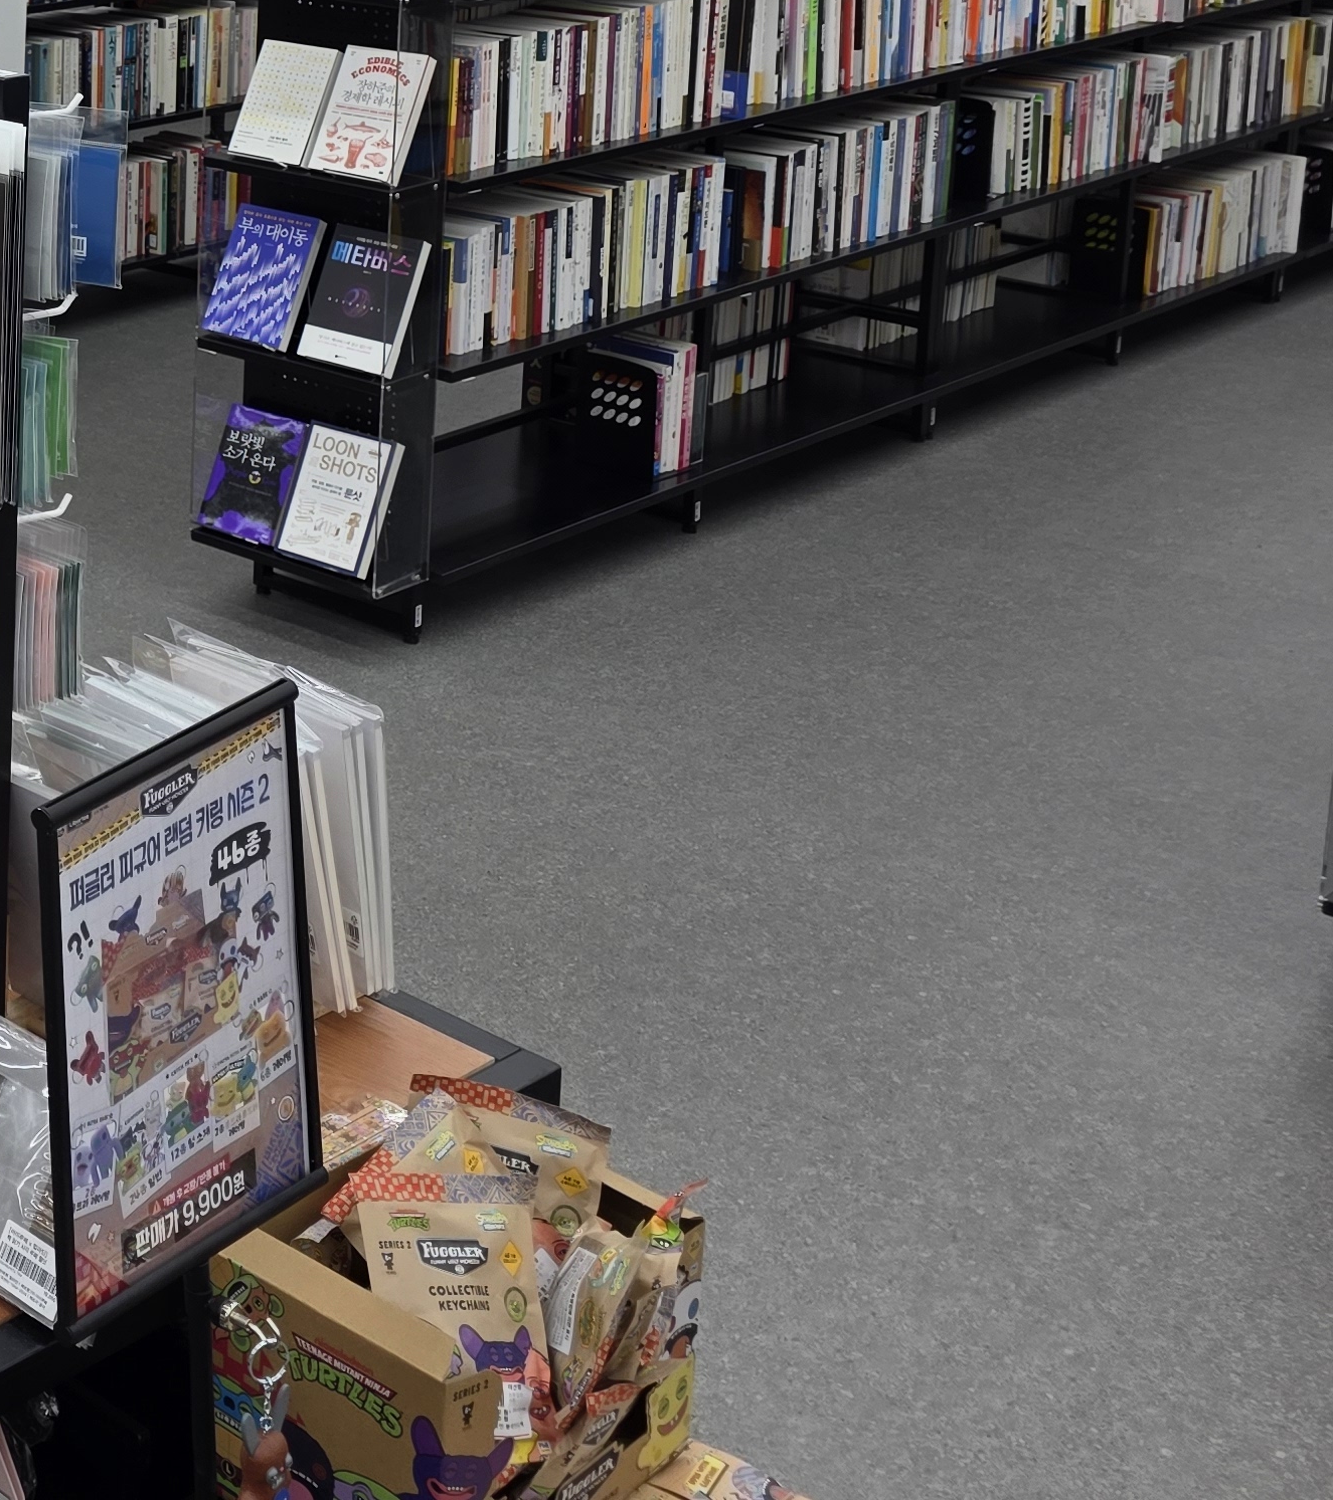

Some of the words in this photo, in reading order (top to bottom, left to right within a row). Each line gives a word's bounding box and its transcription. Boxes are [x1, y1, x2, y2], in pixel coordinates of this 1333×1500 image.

[351, 64, 411, 87] ECONOMICS
[367, 56, 404, 70] EDIBLE
[238, 216, 264, 238] 부의
[266, 223, 309, 248] 대이동
[331, 240, 412, 276] 메타버스
[226, 429, 266, 452] 보랏빛
[312, 432, 361, 460] LOON
[222, 445, 249, 463] 소가
[249, 453, 277, 472] 온다
[319, 454, 378, 484] SHOTS
[142, 771, 196, 810] FUGGLER
[69, 858, 116, 912] 퍼글러
[118, 831, 162, 885] 피규어
[163, 812, 193, 858] 랜덤
[195, 795, 224, 838] 키링
[227, 779, 255, 822] 시즌
[257, 772, 271, 803] 2
[216, 828, 262, 871] 46종
[135, 1213, 180, 1258] 판매가
[182, 1169, 246, 1229] 9,900원
[386, 1217, 431, 1232] TURTLES
[378, 1240, 405, 1250] SERIES
[406, 1240, 413, 1250] 2
[419, 1241, 486, 1262] FUGGLER
[428, 1284, 490, 1296] COLLECTIBLE
[438, 1299, 490, 1311] KEYCHAINS
[295, 1337, 334, 1367] TEENAGE
[332, 1356, 366, 1384] MUTANT
[365, 1375, 392, 1398] NINJA
[283, 1349, 404, 1438] TURTLES
[453, 1384, 481, 1402] SERIES
[482, 1378, 490, 1390] 2
[561, 1458, 616, 1498] FUGGLER
